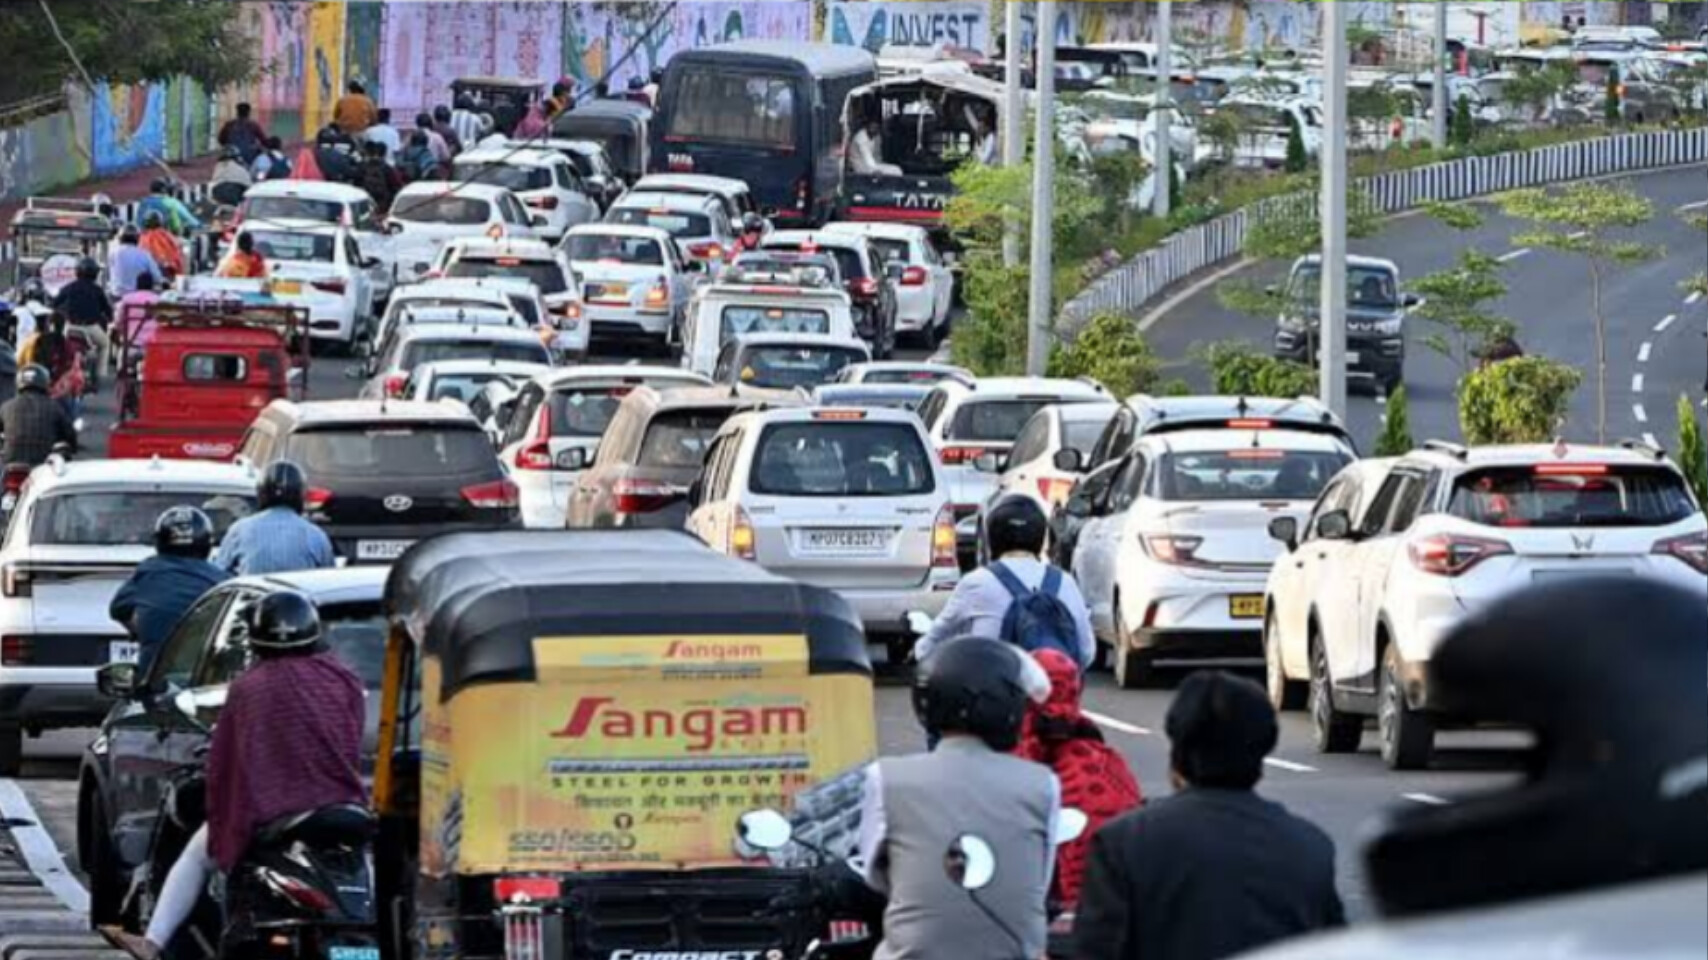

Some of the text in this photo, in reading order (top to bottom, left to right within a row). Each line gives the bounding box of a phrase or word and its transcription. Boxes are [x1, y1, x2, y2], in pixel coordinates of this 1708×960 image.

[891, 12, 980, 49] INVEST
[661, 640, 762, 663] Sangam
[548, 696, 807, 751] Sangam
[552, 773, 807, 788] STEEL FOR GROWTH
